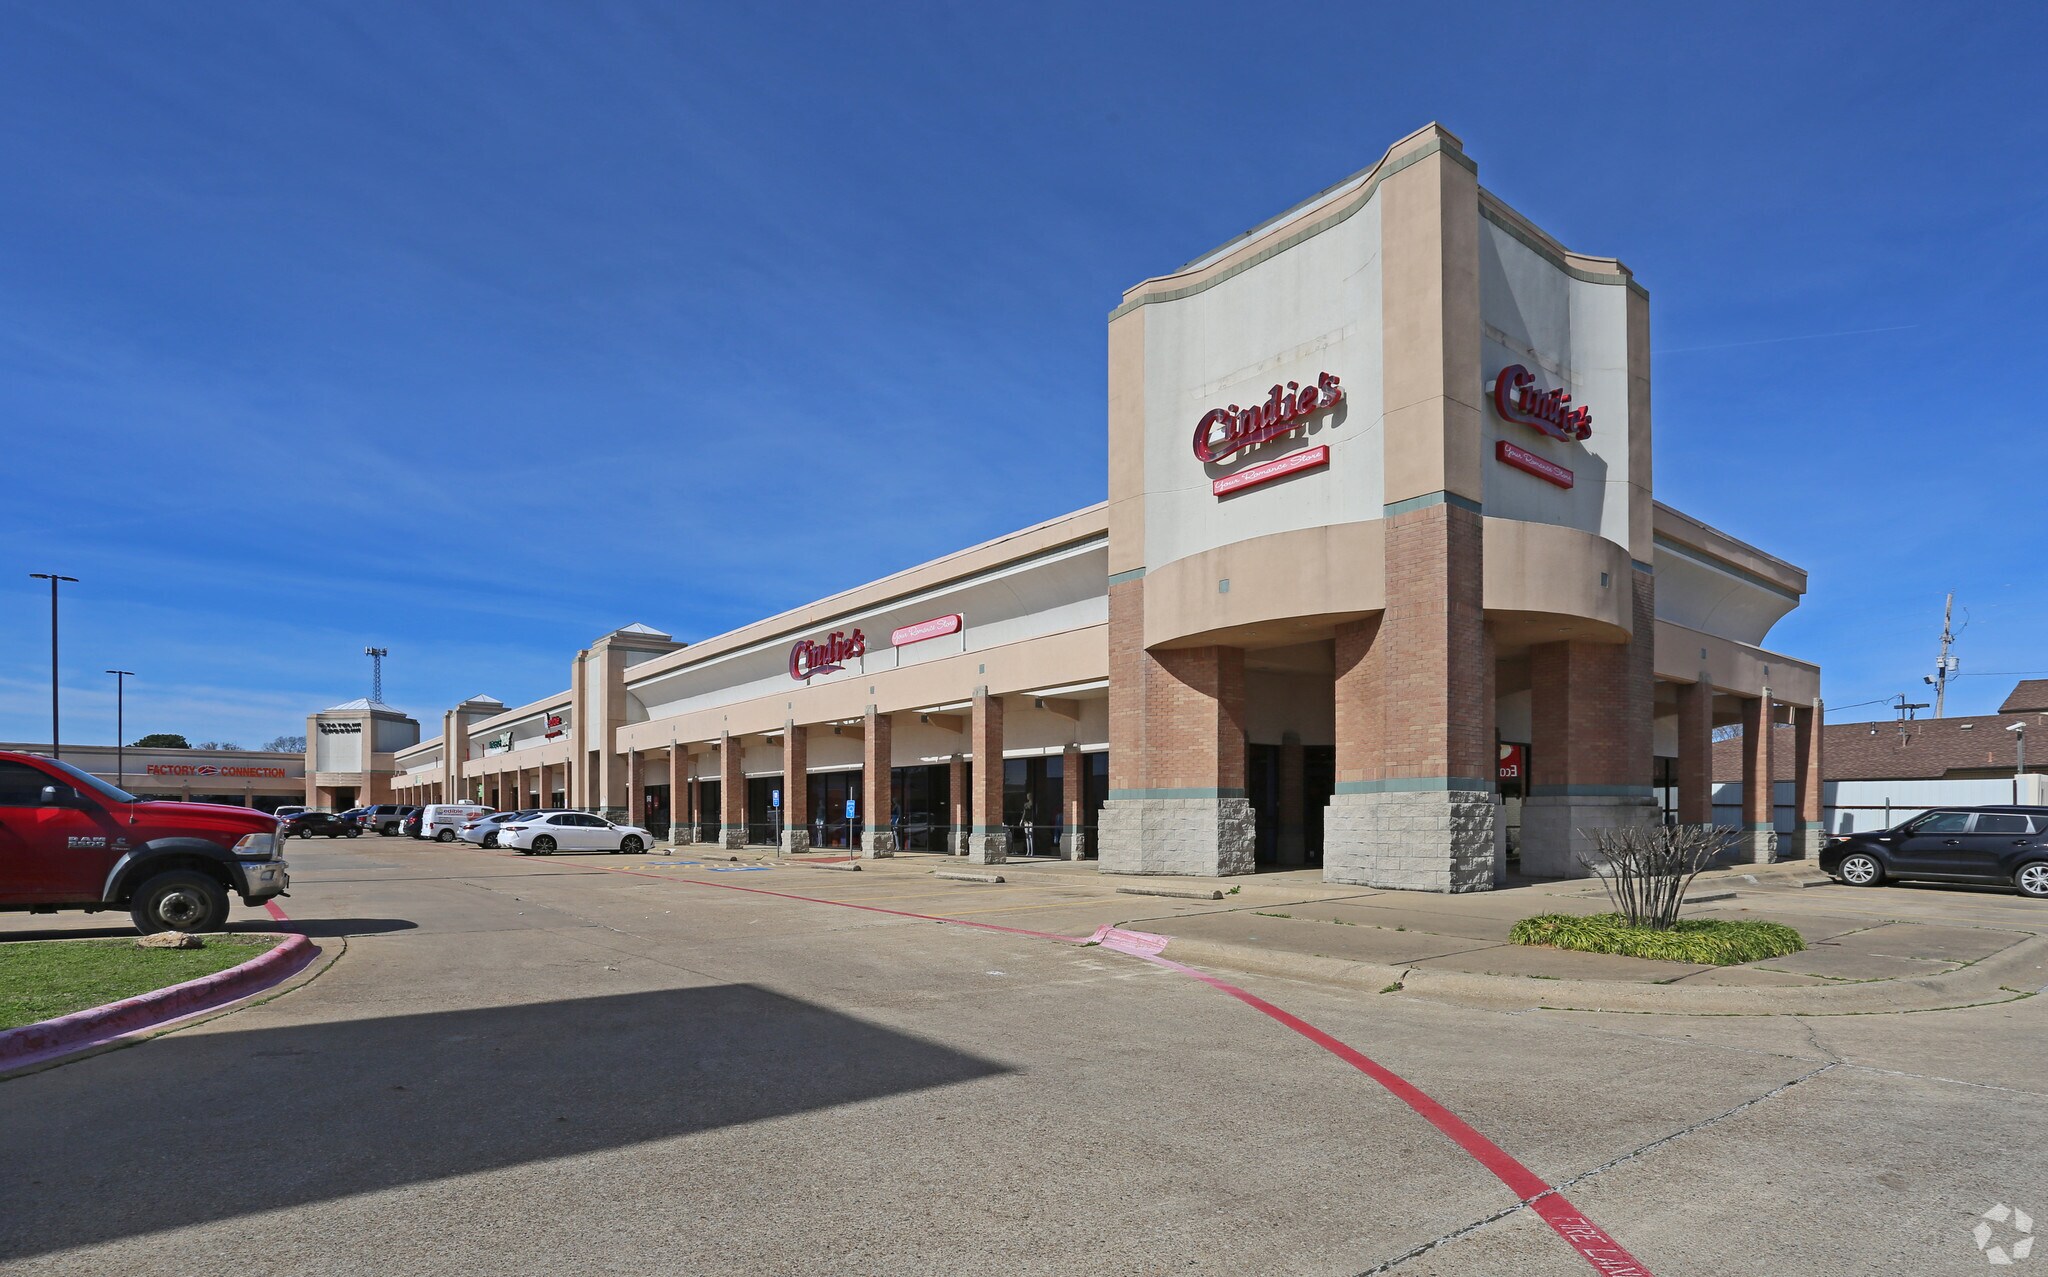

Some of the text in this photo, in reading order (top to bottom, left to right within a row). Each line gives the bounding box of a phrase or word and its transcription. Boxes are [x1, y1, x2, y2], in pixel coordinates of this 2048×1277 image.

[1193, 371, 1342, 463] Cindie's
[1495, 364, 1592, 442] Cindie's
[1214, 451, 1322, 491] Your Romance Store
[1504, 444, 1523, 458] Your
[789, 628, 866, 681] Cindie's
[894, 631, 907, 643] Your
[147, 764, 286, 778] FACTORY CONNECTION
[1551, 1216, 1643, 1277] FIRE LAN
